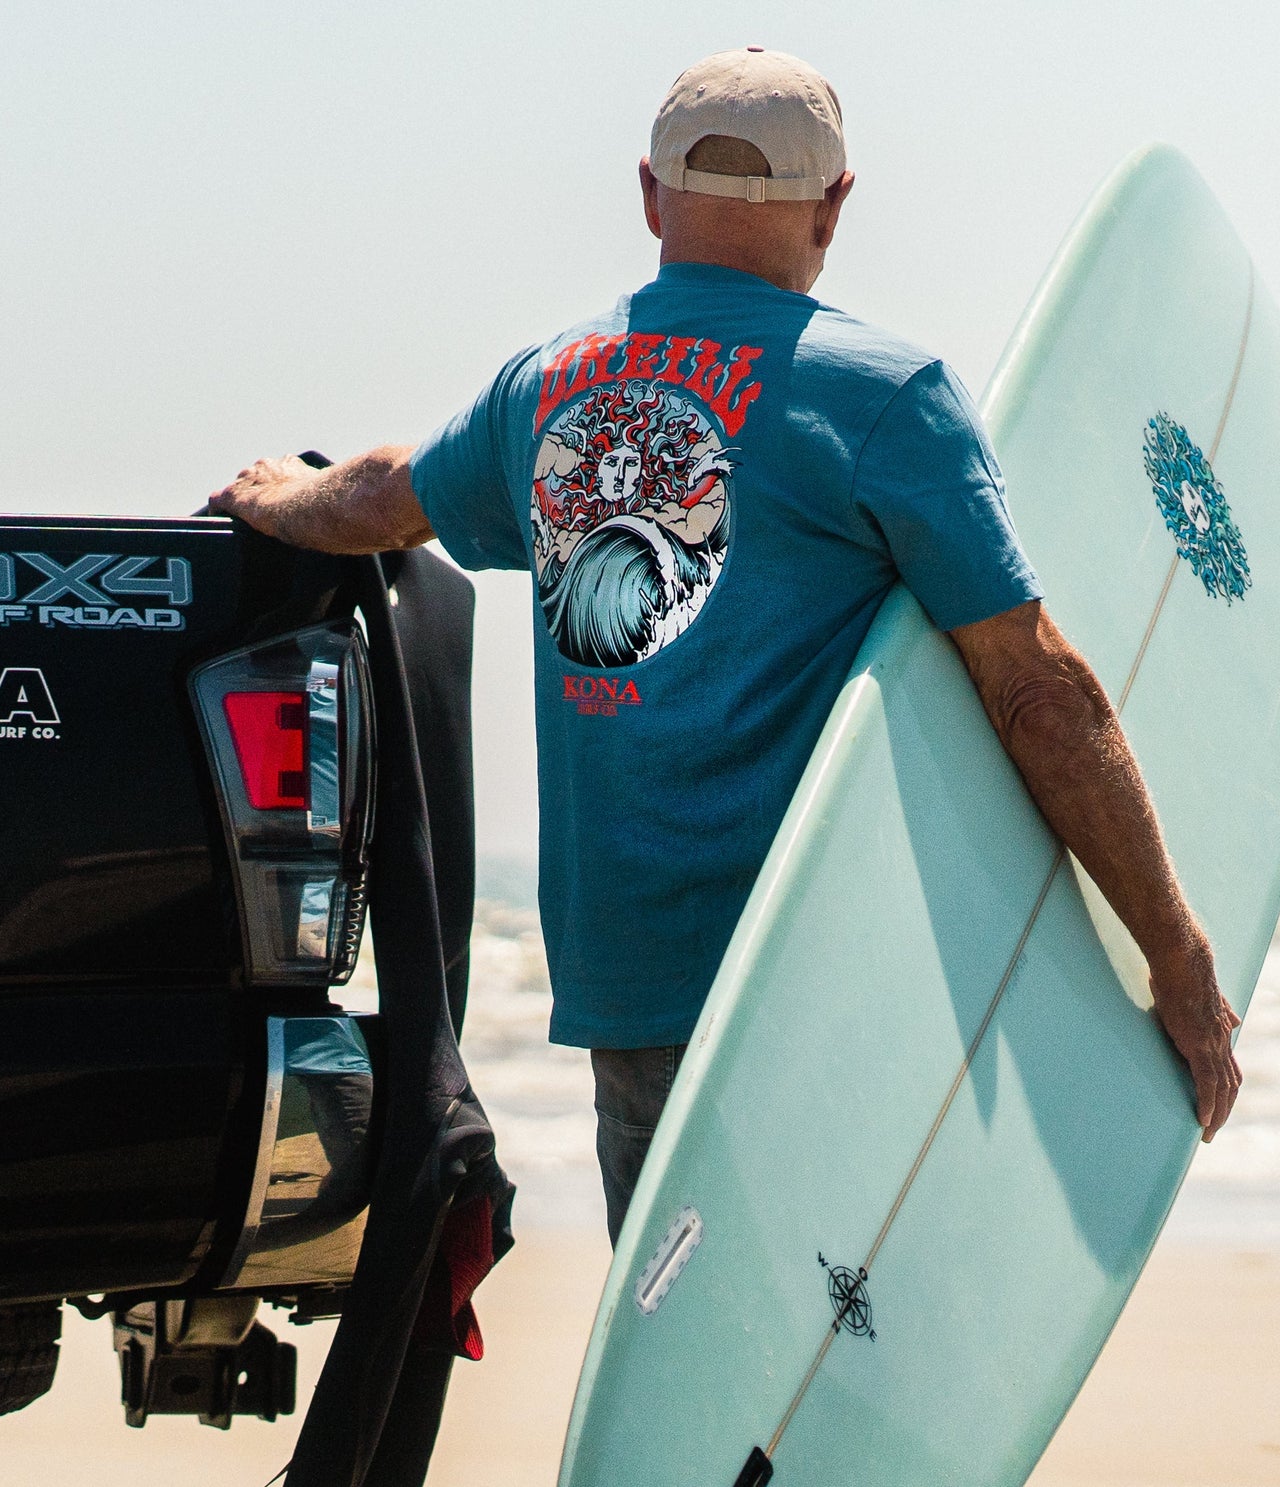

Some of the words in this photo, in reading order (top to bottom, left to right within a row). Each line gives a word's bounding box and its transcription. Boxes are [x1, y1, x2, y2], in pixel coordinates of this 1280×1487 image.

[39, 605, 187, 631] ROAD
[563, 675, 642, 701] KONA
[32, 726, 61, 740] CO.
[818, 1251, 829, 1268] W
[869, 1328, 878, 1343] E
